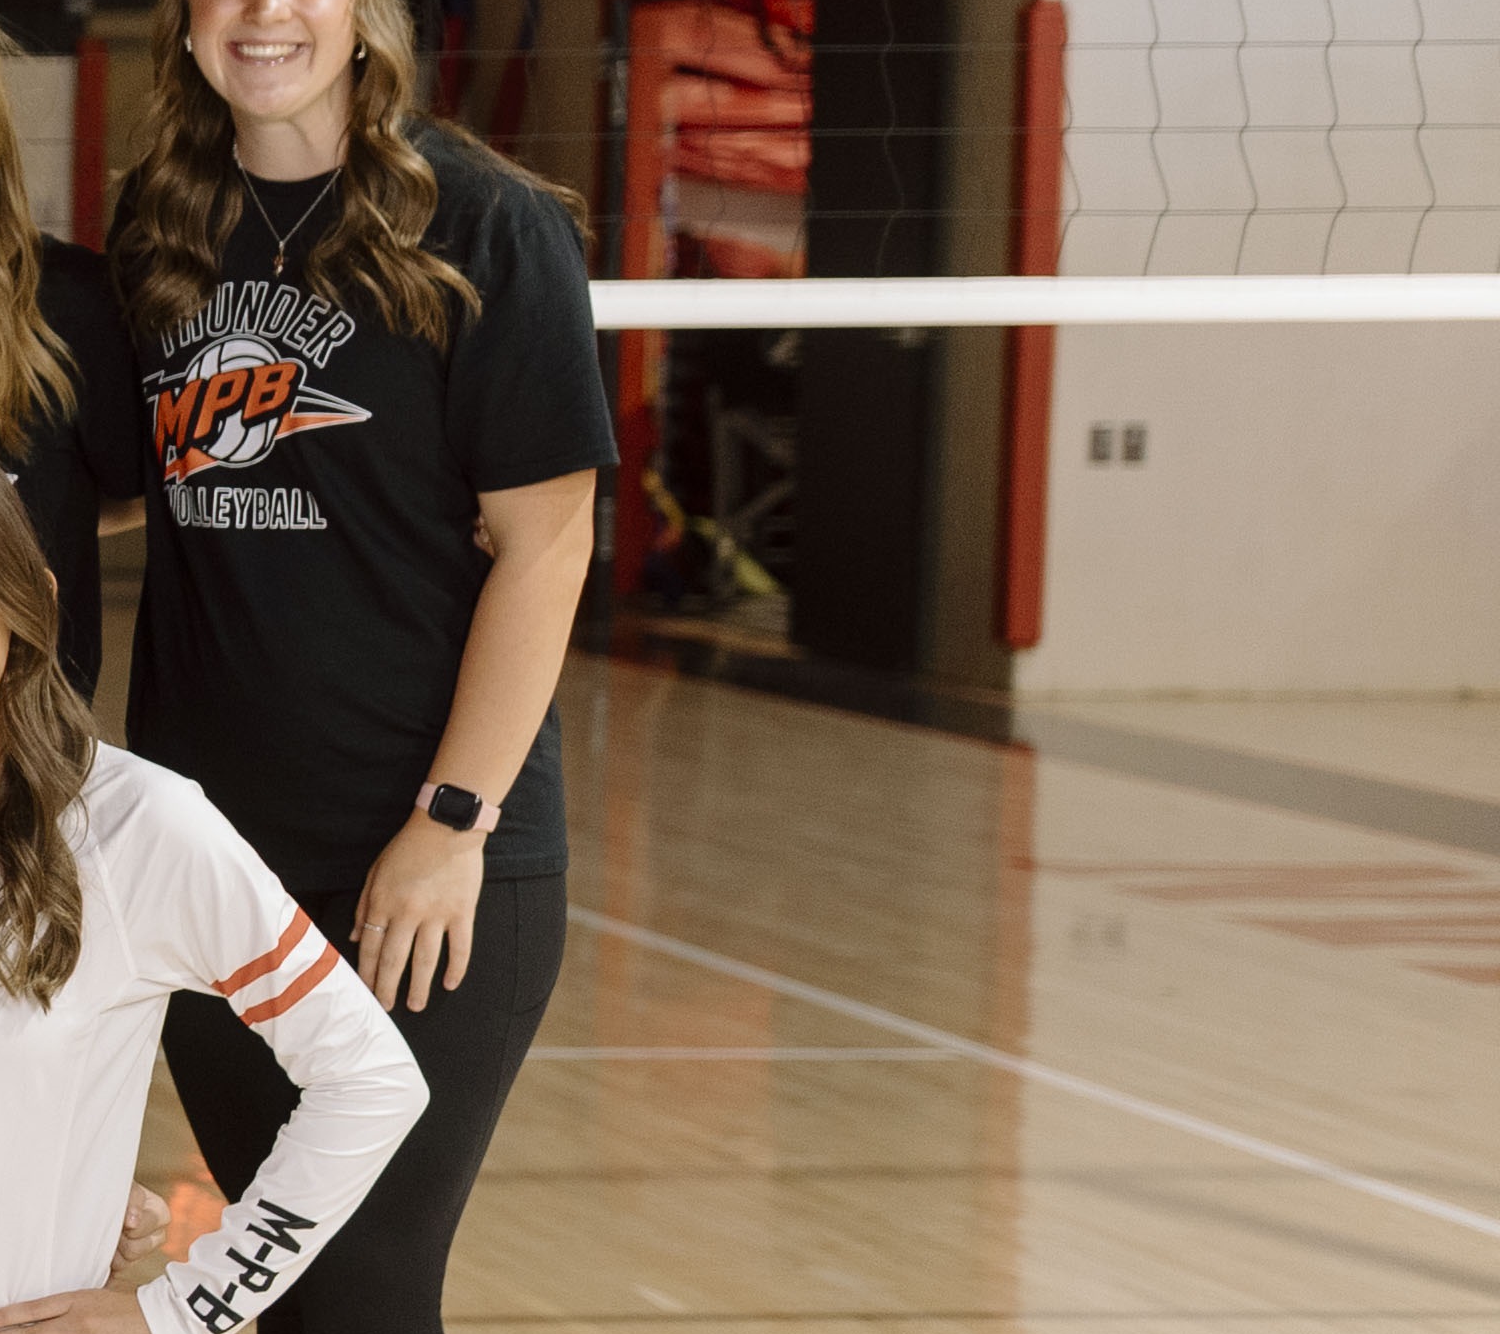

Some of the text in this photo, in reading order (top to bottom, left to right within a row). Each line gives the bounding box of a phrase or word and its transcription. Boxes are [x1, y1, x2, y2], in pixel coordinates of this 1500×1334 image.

[160, 280, 356, 369] UNDER
[155, 361, 298, 465] MPB
[164, 486, 328, 529] VOLLEYBALL
